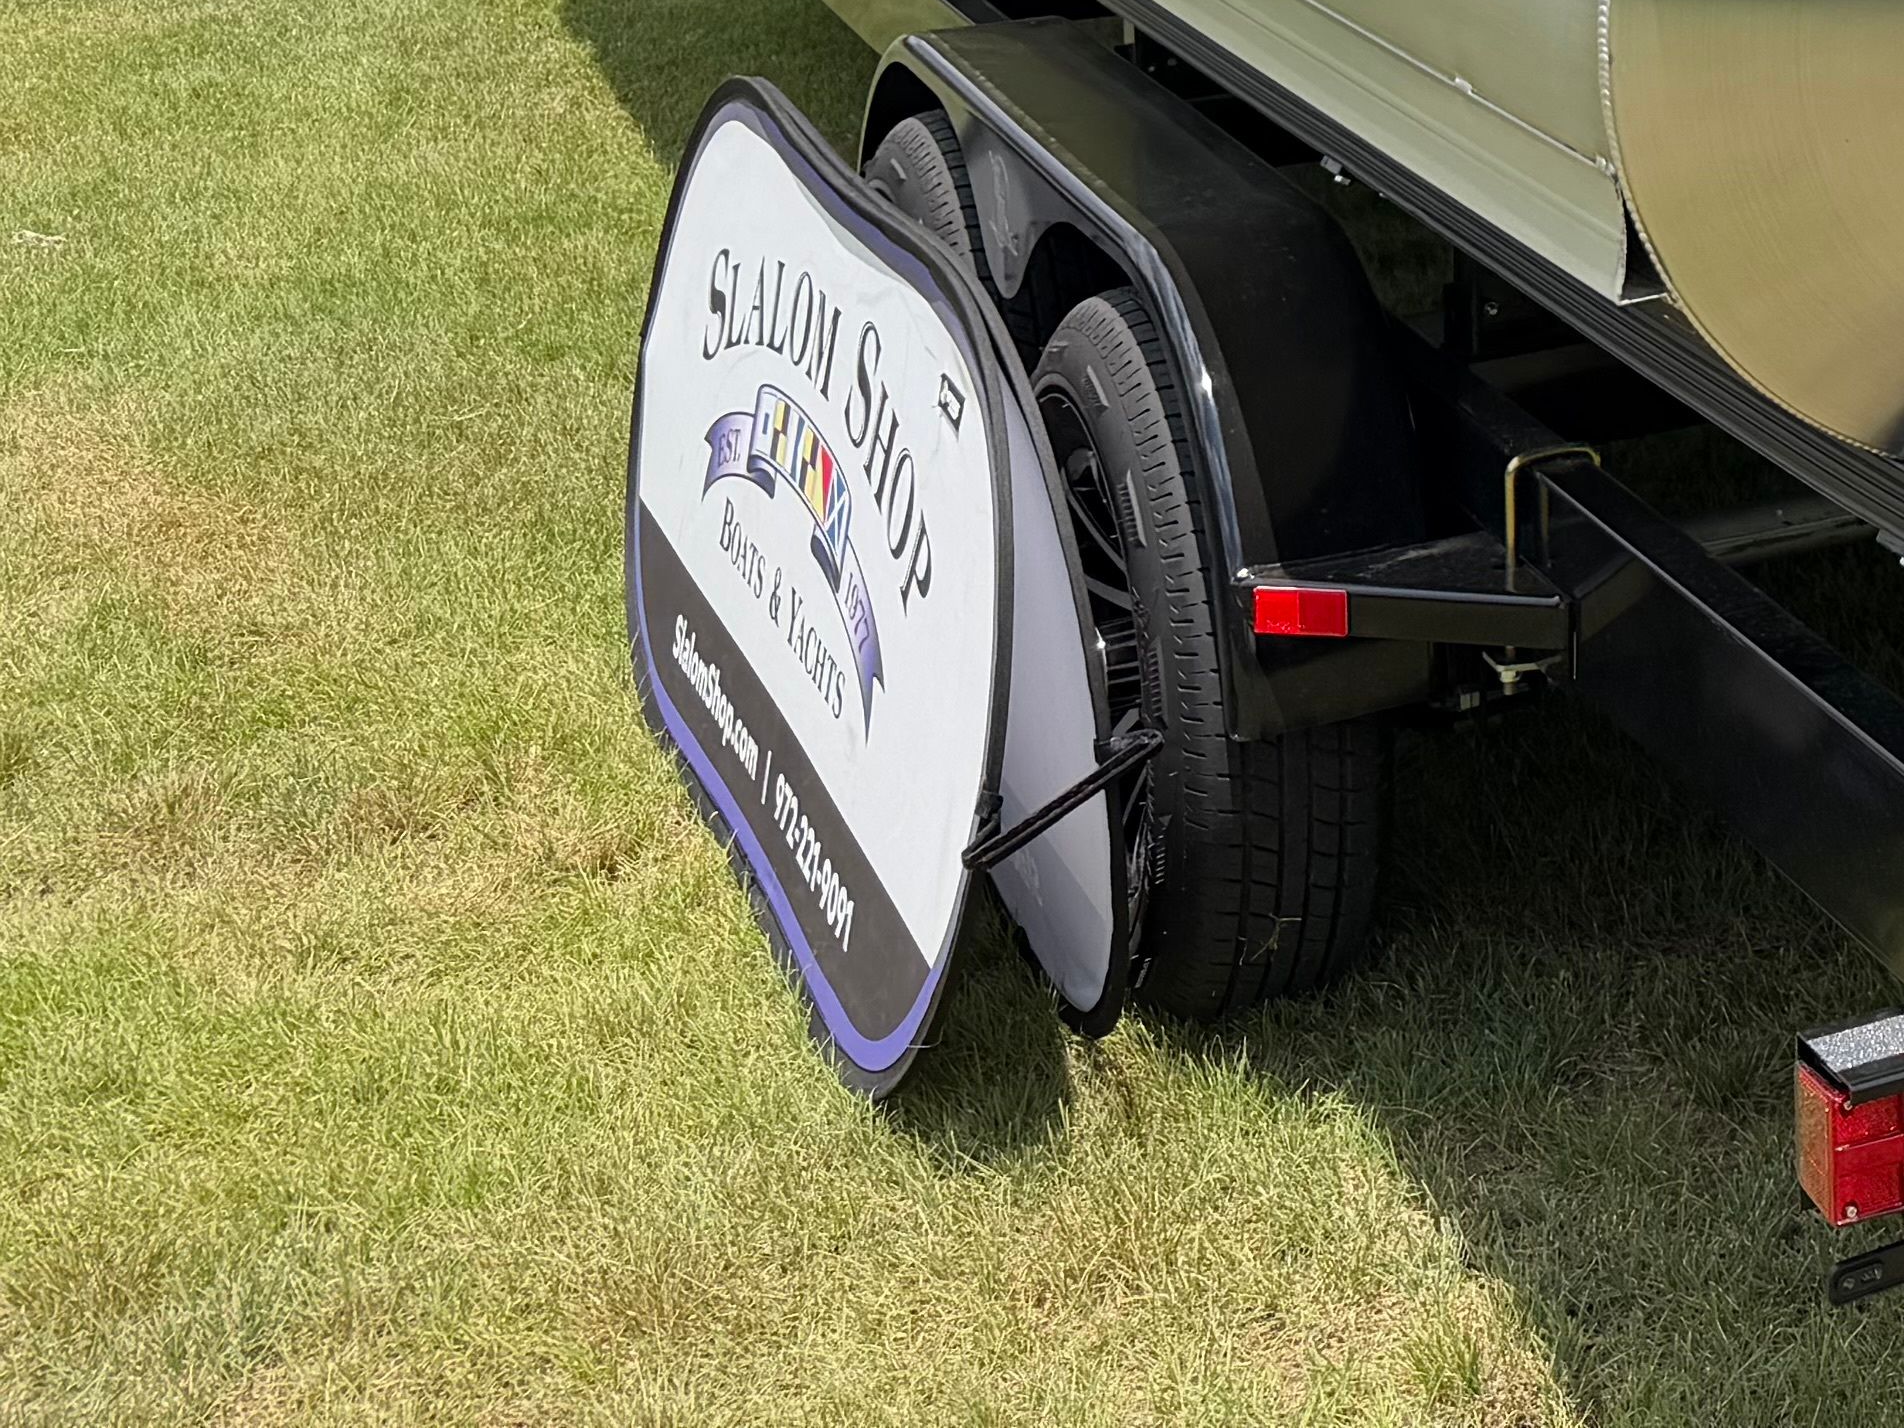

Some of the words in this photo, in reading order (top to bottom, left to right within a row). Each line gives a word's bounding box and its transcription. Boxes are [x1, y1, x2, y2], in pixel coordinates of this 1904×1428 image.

[702, 247, 842, 402] SLALOM
[844, 320, 932, 617] SHOP
[717, 428, 741, 468] EST.
[844, 571, 870, 653] 1977
[719, 496, 767, 599] BOATS
[768, 566, 782, 628] &
[787, 586, 846, 719] YACHTS
[672, 613, 760, 781] SlalomShop.com
[773, 772, 855, 953] 972-221-9091
